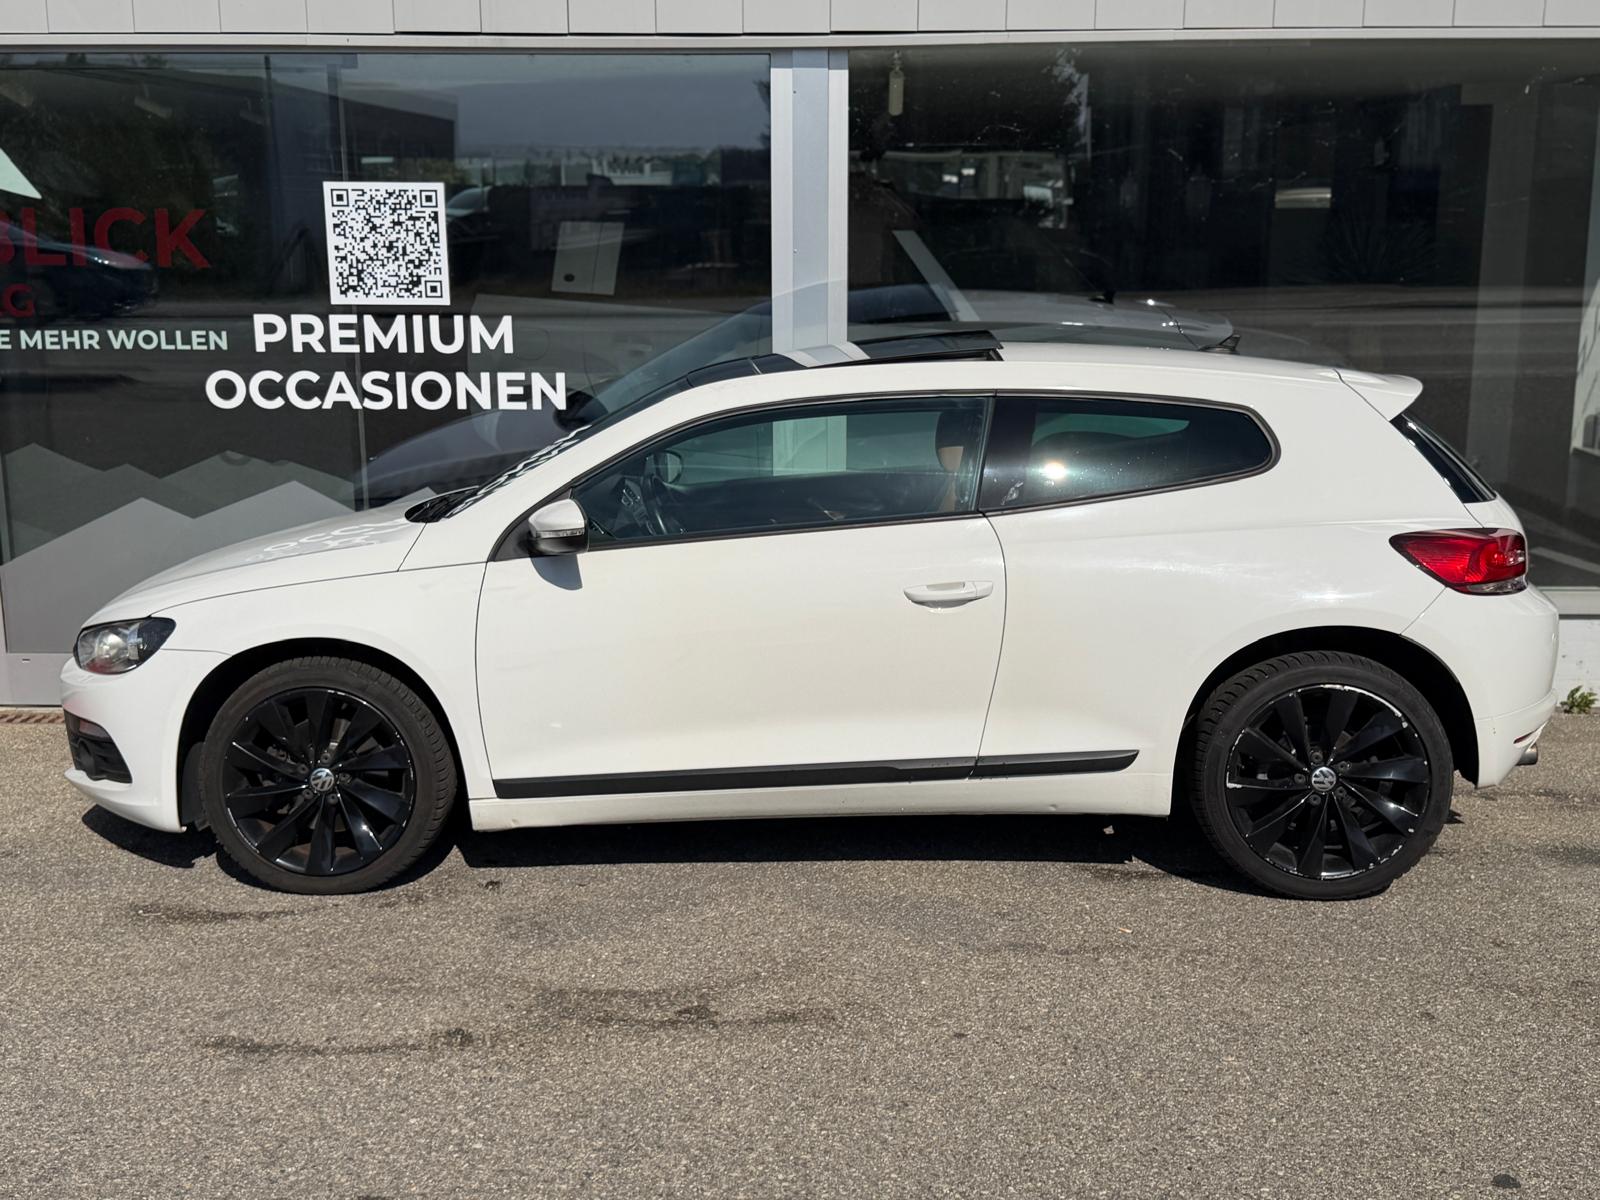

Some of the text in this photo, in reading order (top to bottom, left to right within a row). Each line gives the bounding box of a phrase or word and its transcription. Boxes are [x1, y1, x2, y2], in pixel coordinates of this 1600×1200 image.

[19, 329, 100, 350] MEHR
[107, 330, 229, 351] WOLLEN
[252, 313, 514, 354] PREMIUM
[205, 369, 567, 411] OCCASIONEN
